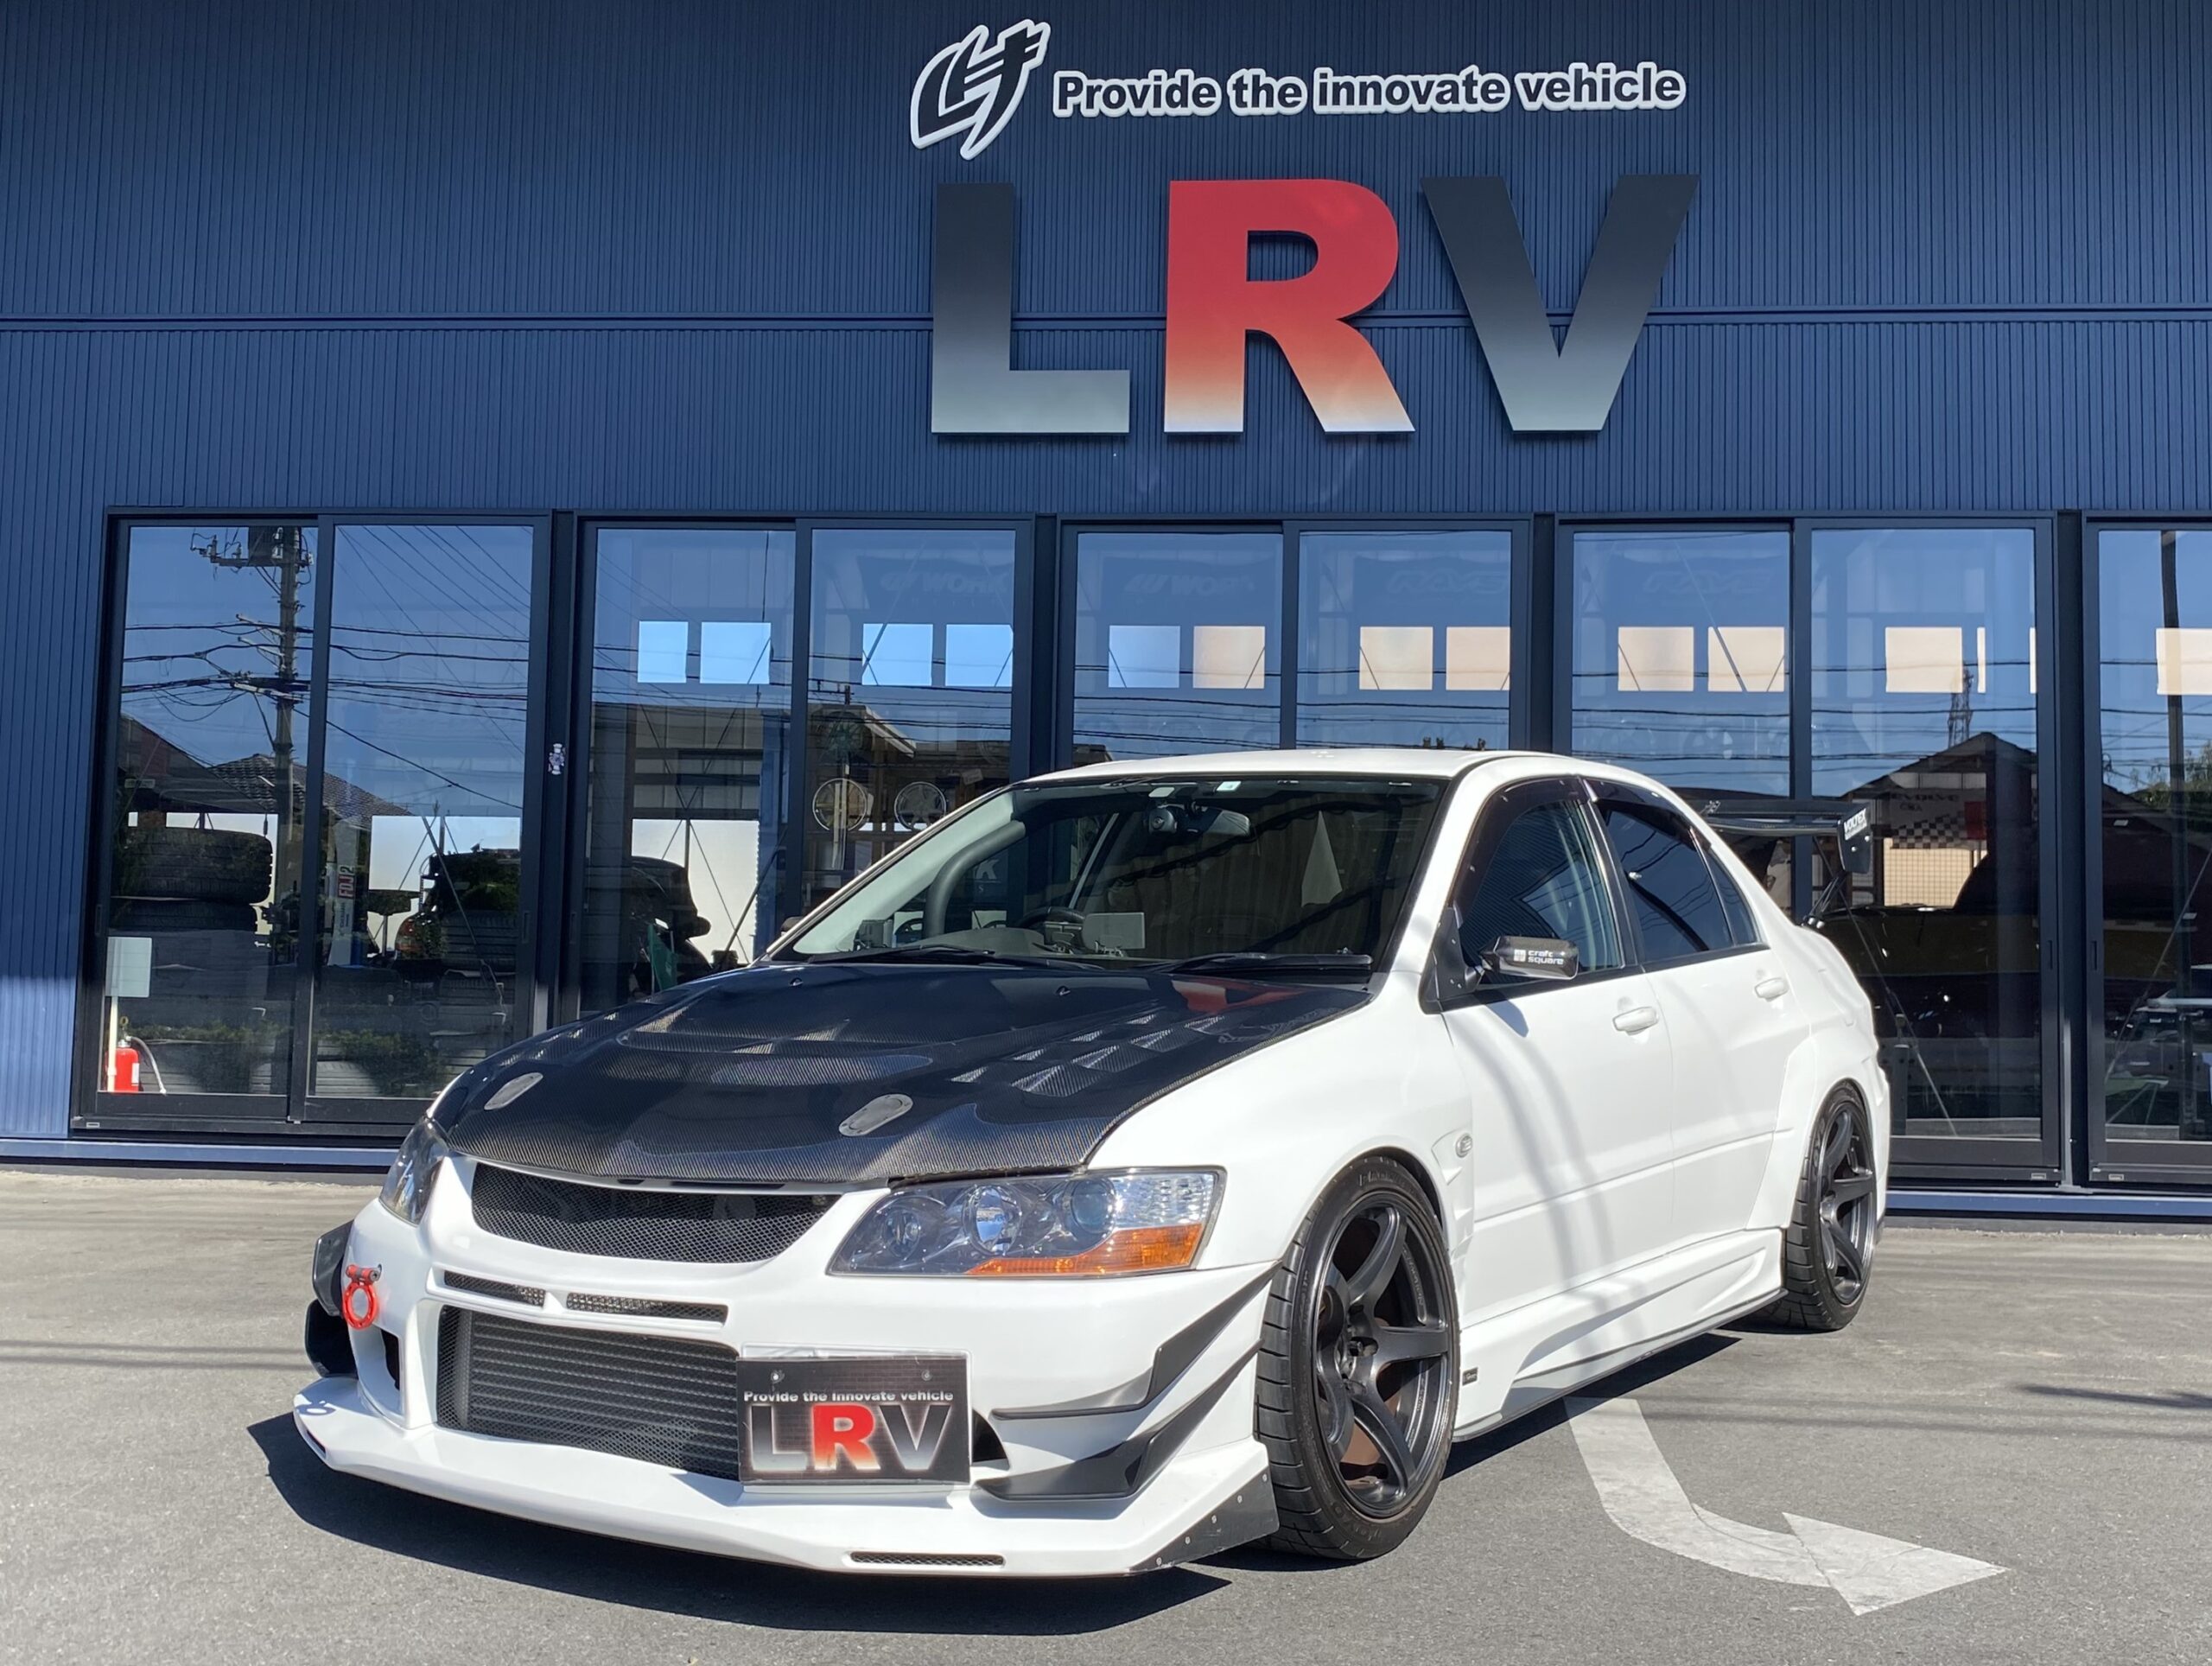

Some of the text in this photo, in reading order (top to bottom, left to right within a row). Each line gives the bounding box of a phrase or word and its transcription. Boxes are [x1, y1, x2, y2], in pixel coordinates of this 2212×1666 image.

[1054, 63, 1685, 117] Provide the innovate vehicle
[931, 175, 1700, 434] LRV
[1527, 956, 1565, 965] square
[743, 1390, 954, 1402] Provide the innovate vehicle
[750, 1403, 951, 1471] LRV
